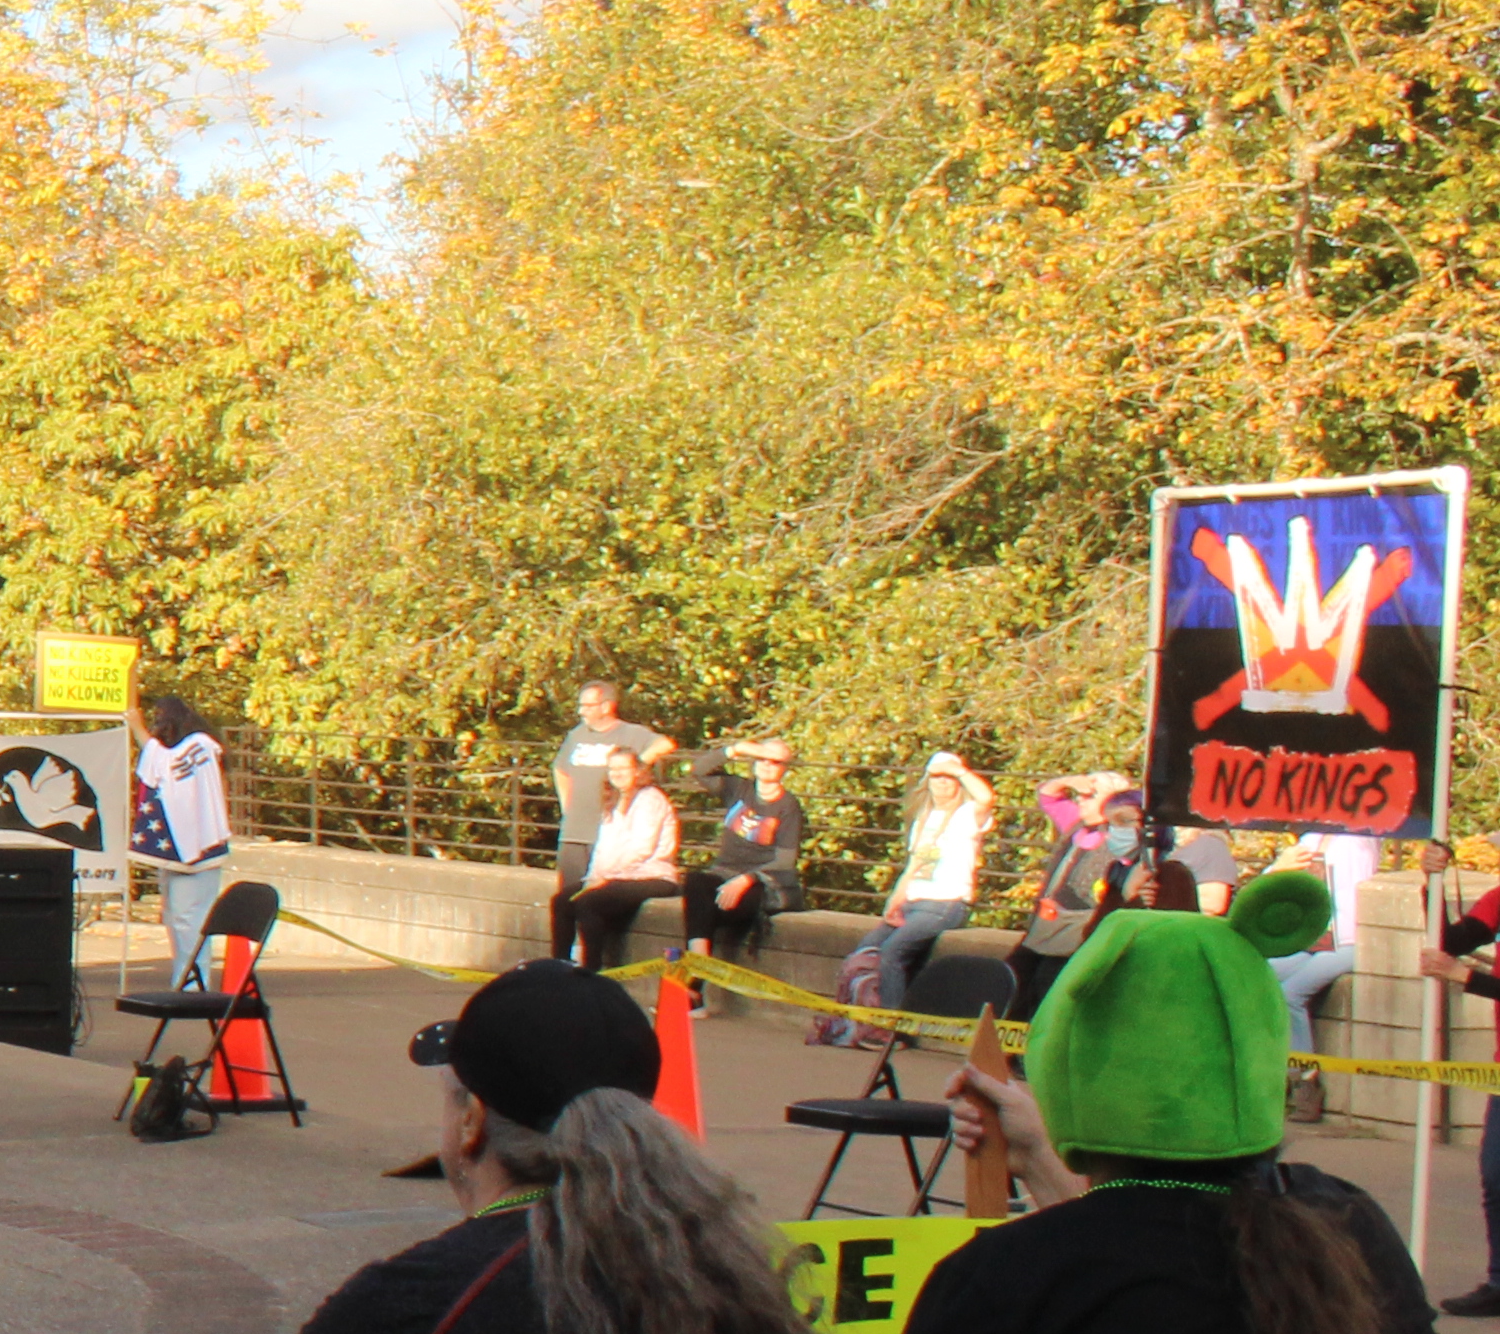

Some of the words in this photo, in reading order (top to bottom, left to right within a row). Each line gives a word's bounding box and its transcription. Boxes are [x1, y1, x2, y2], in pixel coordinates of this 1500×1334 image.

[68, 667, 119, 683] KILLERS
[48, 684, 64, 698] NO
[67, 685, 123, 703] KLOWNS
[1211, 758, 1265, 808] NO
[1274, 759, 1394, 816] KINGS
